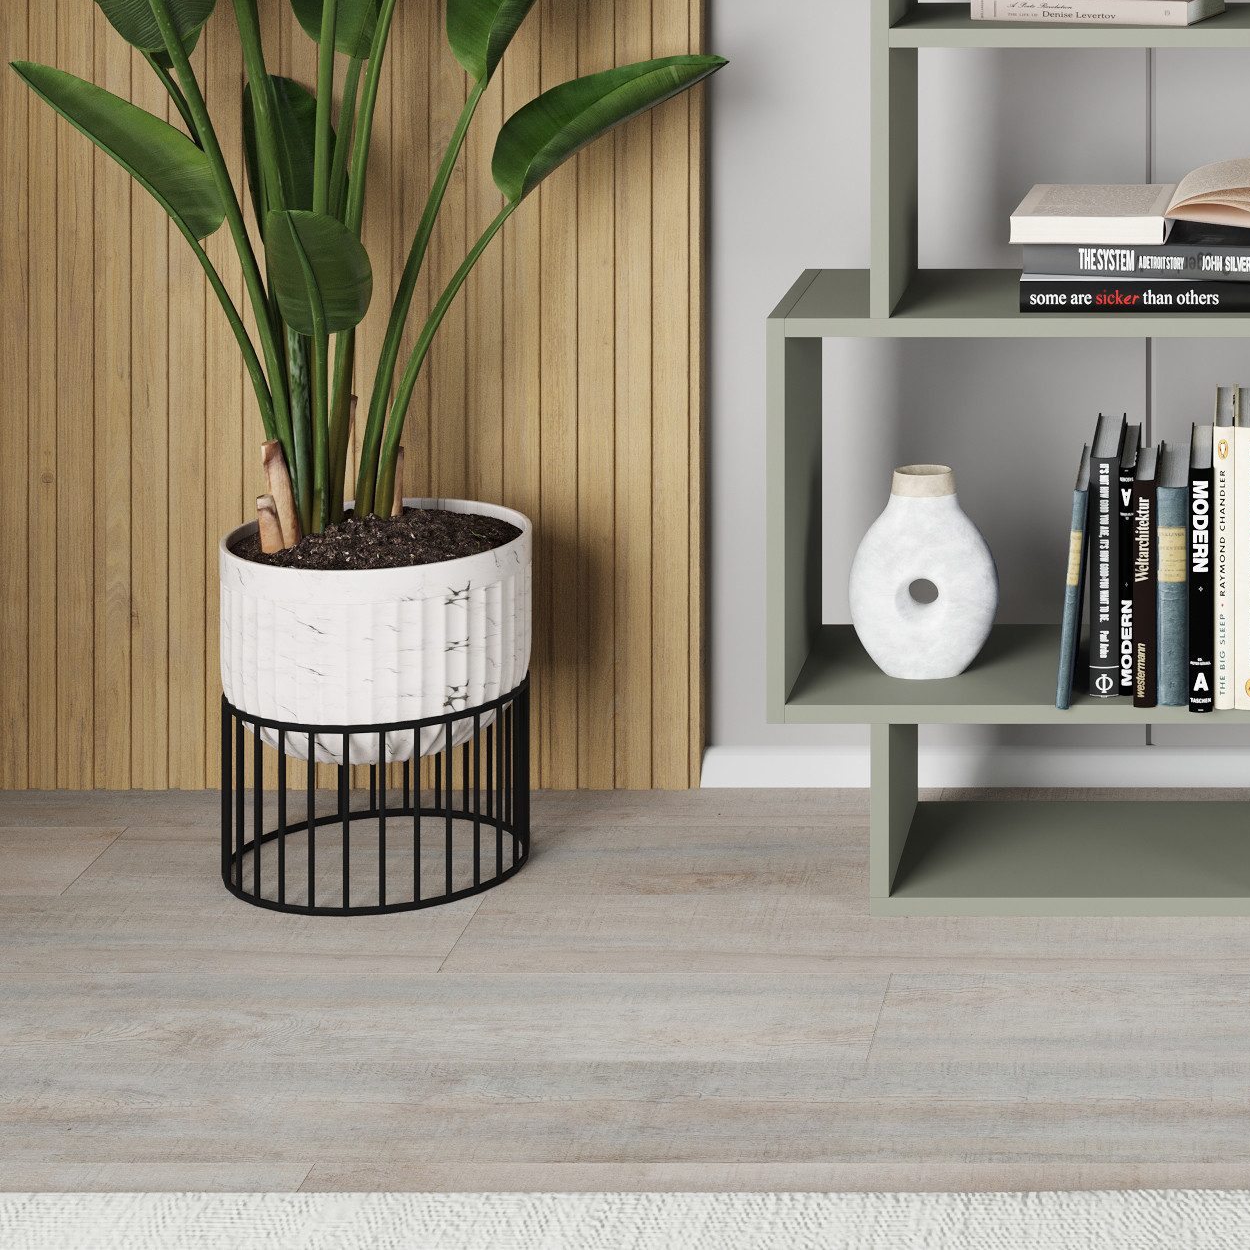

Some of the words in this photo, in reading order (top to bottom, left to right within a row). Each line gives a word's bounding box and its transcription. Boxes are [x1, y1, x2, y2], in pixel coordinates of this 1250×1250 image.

[1042, 10, 1073, 19] Denise
[1076, 11, 1116, 20] Levertov
[1201, 255, 1223, 271] JOHN
[1029, 293, 1067, 305] some
[1070, 293, 1093, 305] are
[1095, 290, 1140, 306] sicker
[1143, 290, 1174, 305] than
[1176, 290, 1219, 306] others
[1134, 496, 1150, 583] Weltarchitektur
[1192, 480, 1209, 573] MODERN
[1121, 600, 1132, 686] MODERN
[1136, 642, 1146, 698] westermann
[1193, 672, 1209, 692] A
